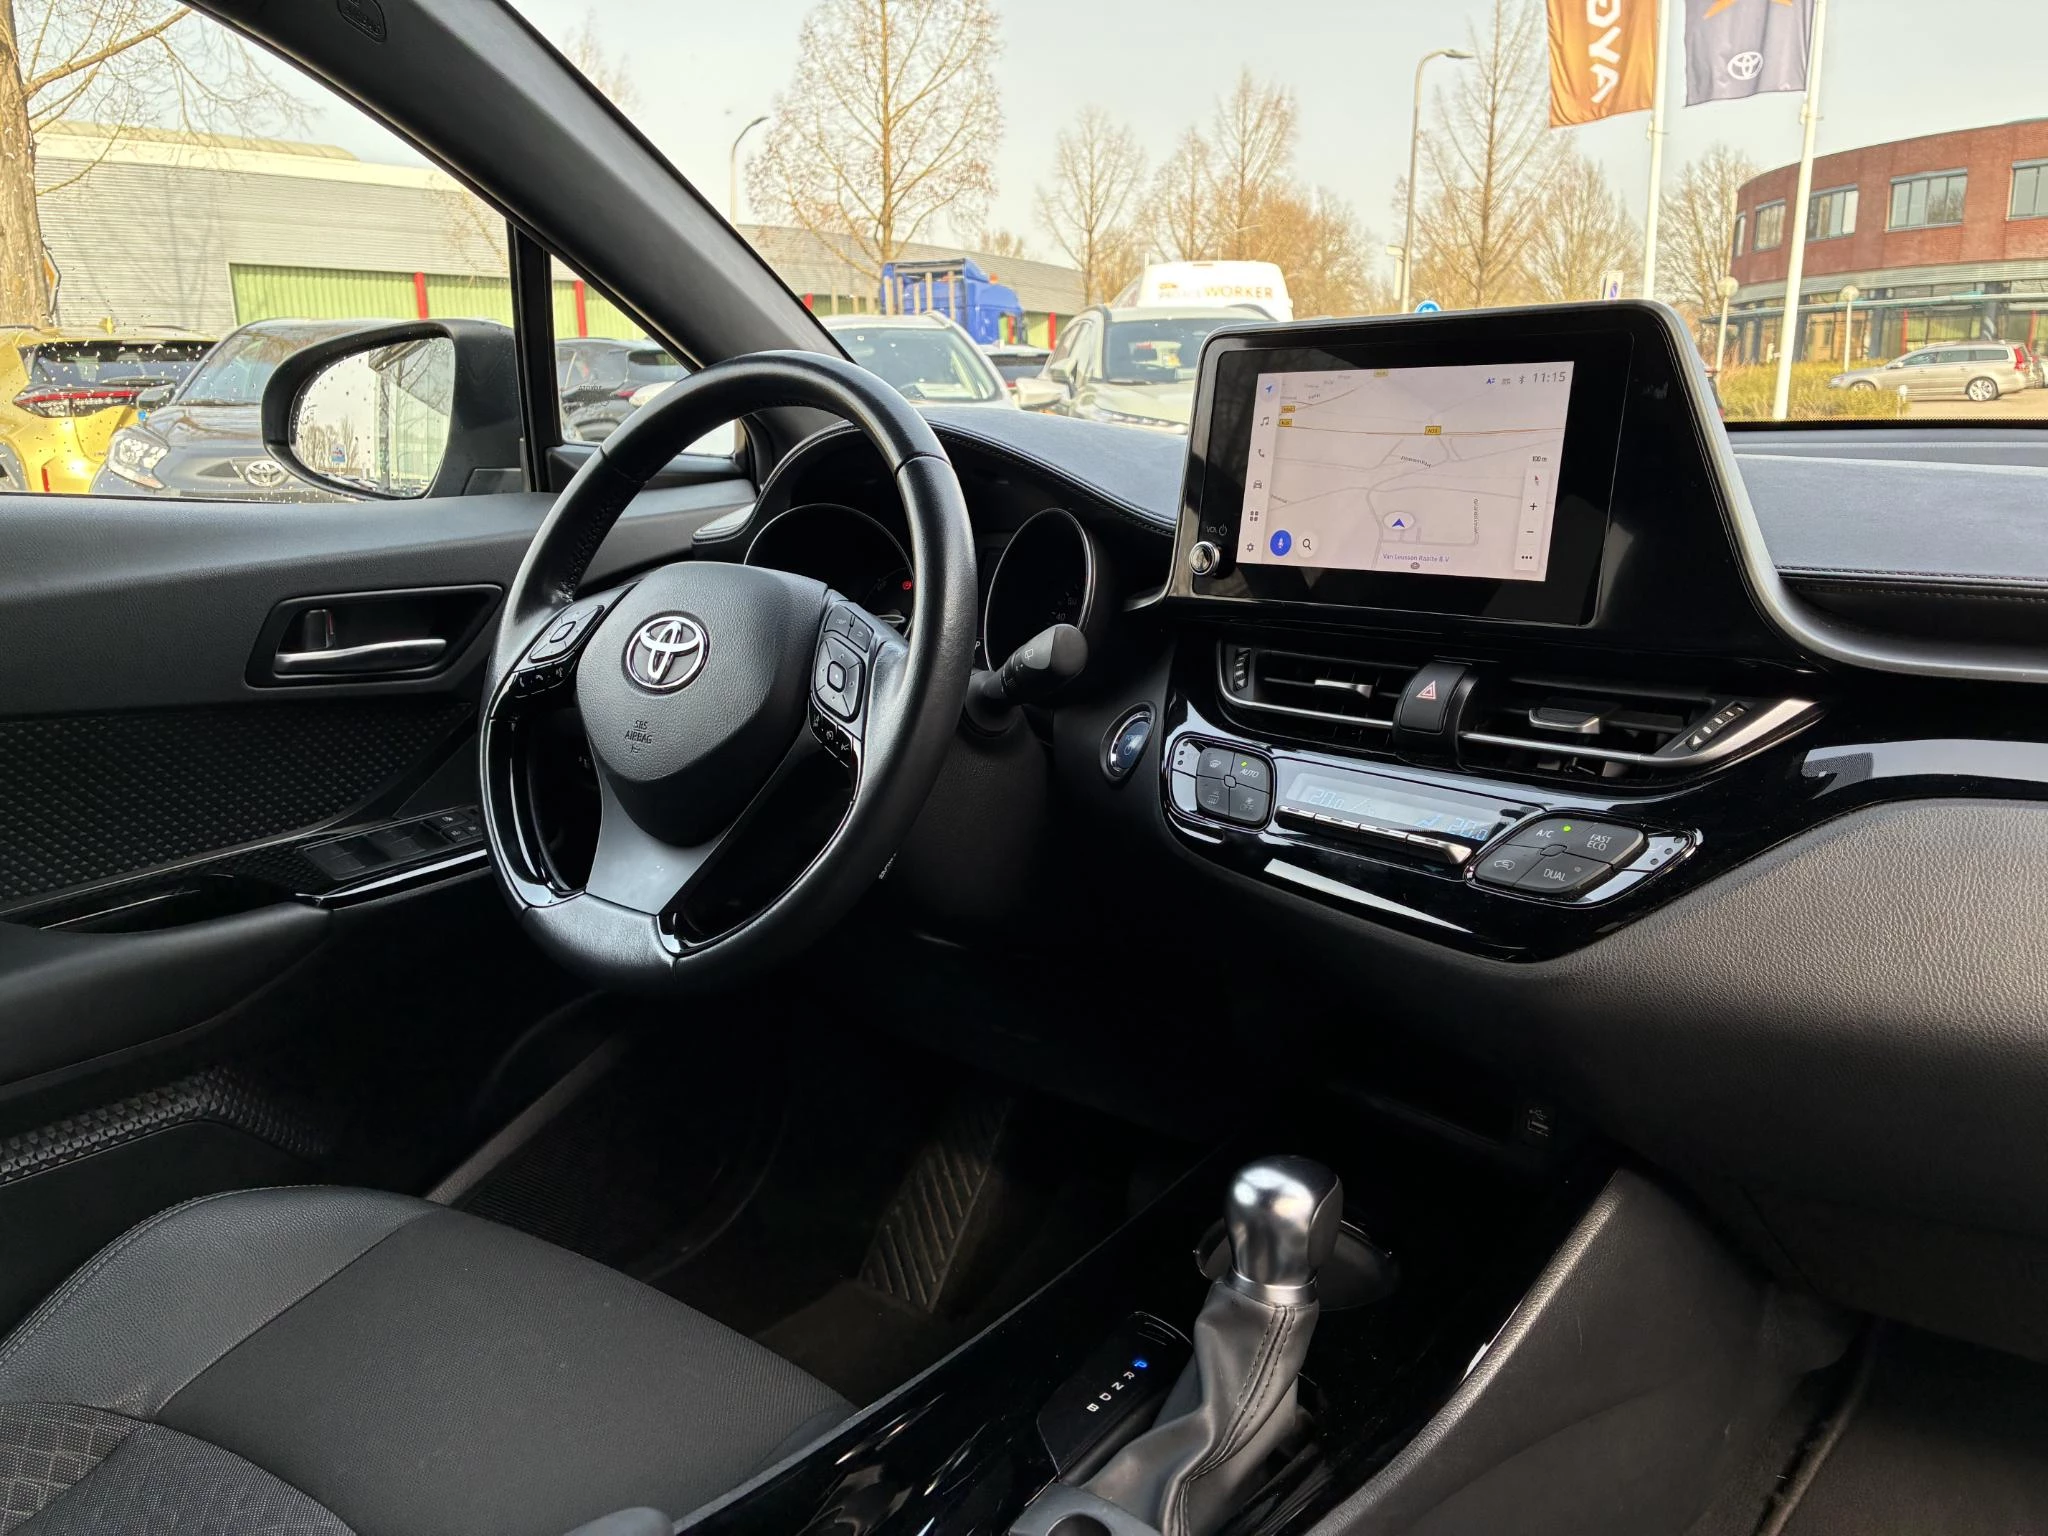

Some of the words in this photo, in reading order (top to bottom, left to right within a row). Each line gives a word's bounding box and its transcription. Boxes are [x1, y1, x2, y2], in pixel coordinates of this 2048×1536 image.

[1205, 286, 1273, 298] WORKER
[1532, 371, 1567, 384] 11:15
[634, 720, 648, 730] SRS
[624, 730, 653, 744] AIRBAG
[1240, 768, 1259, 778] AUTO
[1448, 816, 1489, 842] 20.0
[1536, 829, 1553, 839] A/C
[1590, 833, 1612, 844] FAST
[1586, 840, 1607, 851] ECO
[1543, 868, 1567, 882] DUAL
[1134, 1360, 1148, 1369] P
[1123, 1371, 1135, 1380] R
[1111, 1381, 1125, 1391] N
[1099, 1392, 1112, 1401] D
[1086, 1403, 1100, 1412] B
